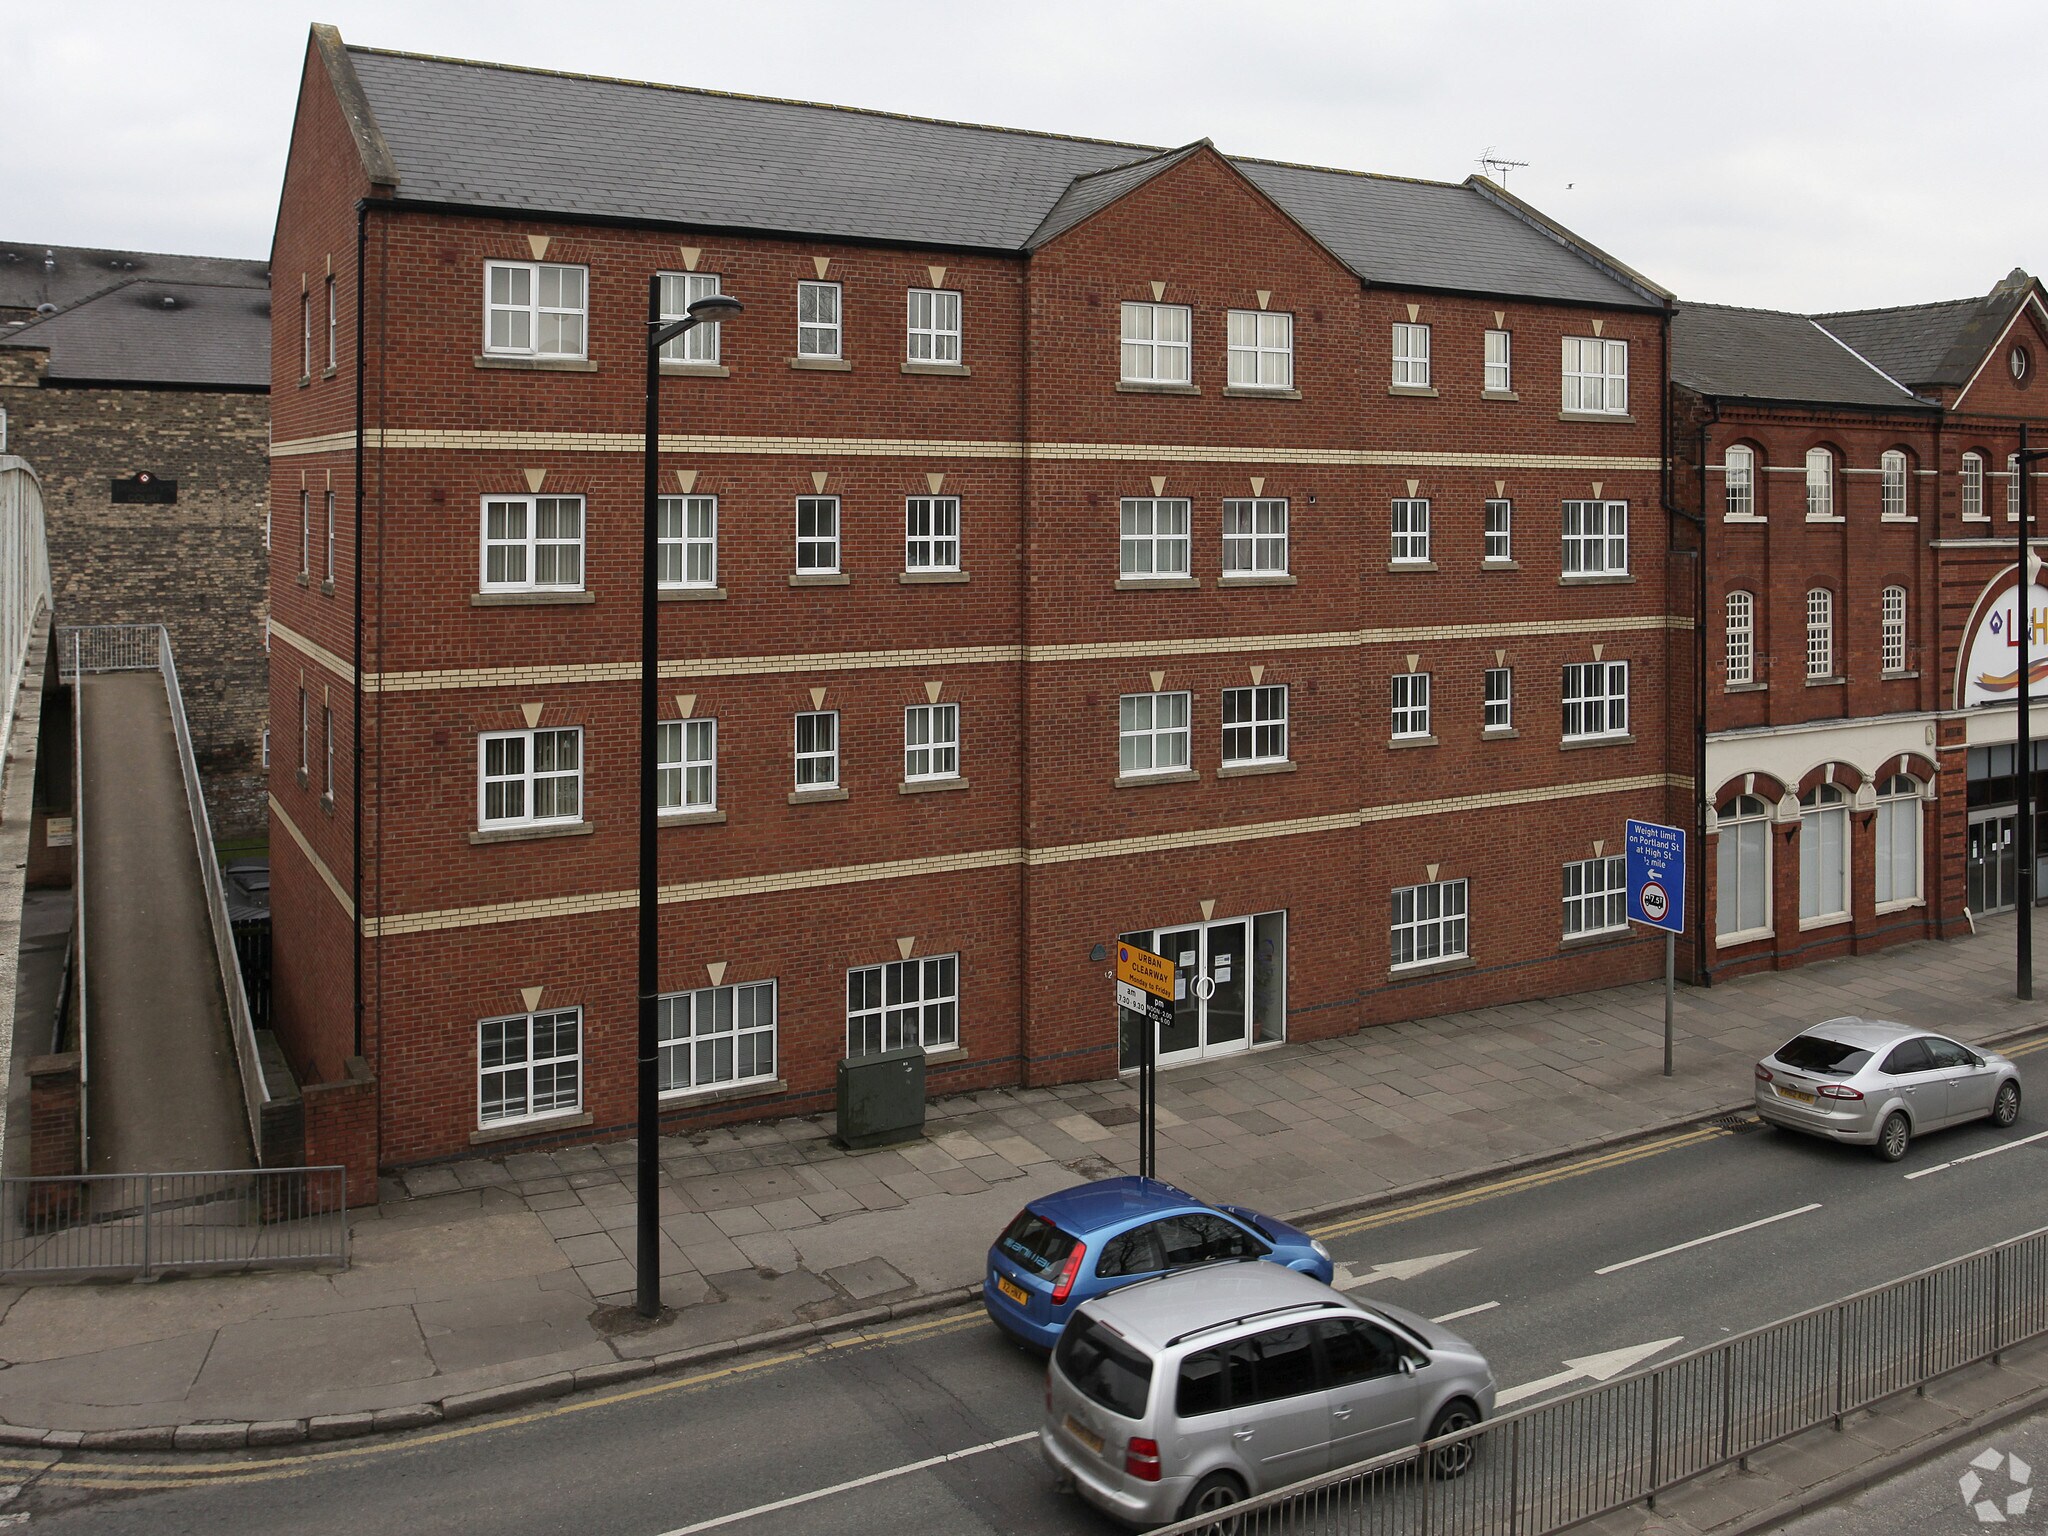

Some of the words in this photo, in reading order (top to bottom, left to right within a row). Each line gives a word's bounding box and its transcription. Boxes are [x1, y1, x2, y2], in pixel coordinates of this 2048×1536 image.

[1634, 825, 1658, 837] Weight
[1660, 830, 1676, 841] limit
[1629, 835, 1638, 843] on
[1639, 835, 1669, 849] Portland
[1671, 842, 1681, 852] St.
[1636, 846, 1643, 854] at
[1645, 847, 1661, 858] High
[1663, 850, 1673, 860] St.
[1651, 859, 1666, 868] mile
[1138, 952, 1162, 969] URBAN
[1132, 962, 1168, 983] CLEARWAY
[1127, 988, 1136, 998] am
[1129, 973, 1148, 989] Monday
[1149, 982, 1154, 990] to
[1155, 985, 1171, 998] Friday
[1155, 999, 1164, 1008] pm
